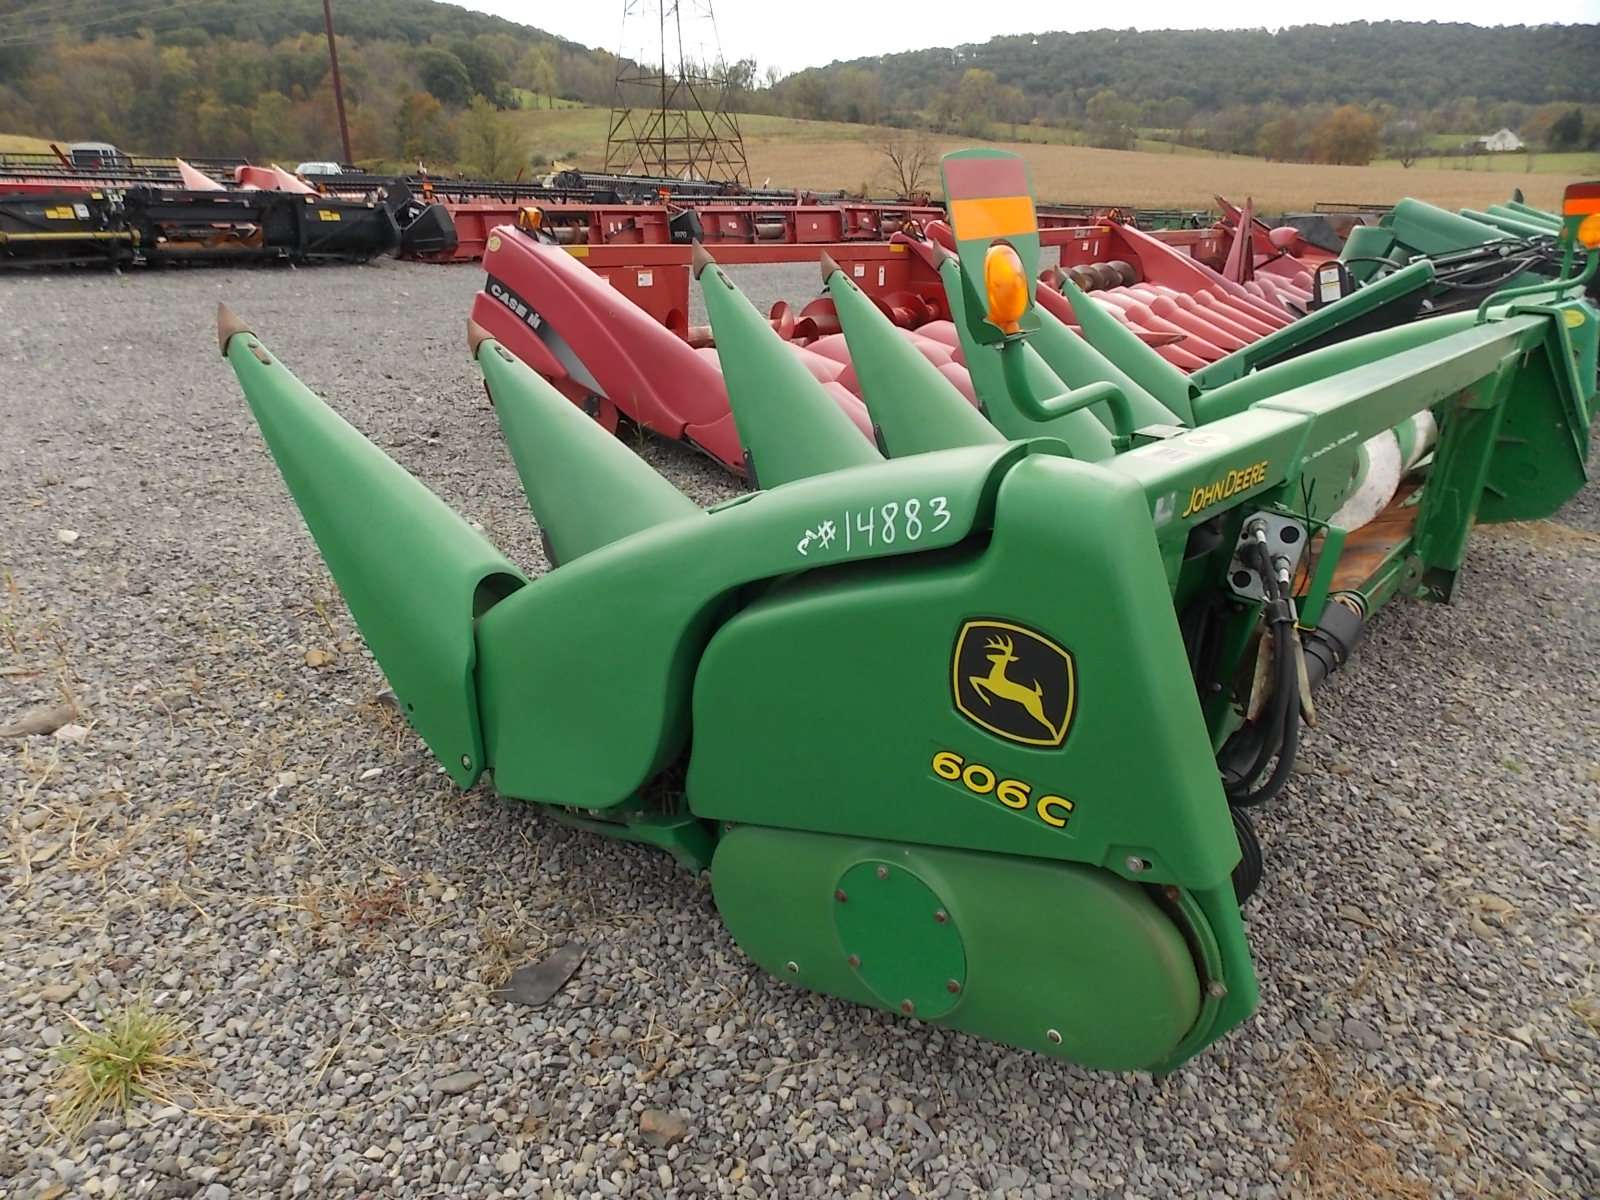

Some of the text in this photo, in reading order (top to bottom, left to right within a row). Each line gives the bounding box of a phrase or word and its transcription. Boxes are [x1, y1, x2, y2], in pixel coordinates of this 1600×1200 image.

[491, 284, 528, 318] CASE
[1182, 460, 1269, 519] JOHN DEERE
